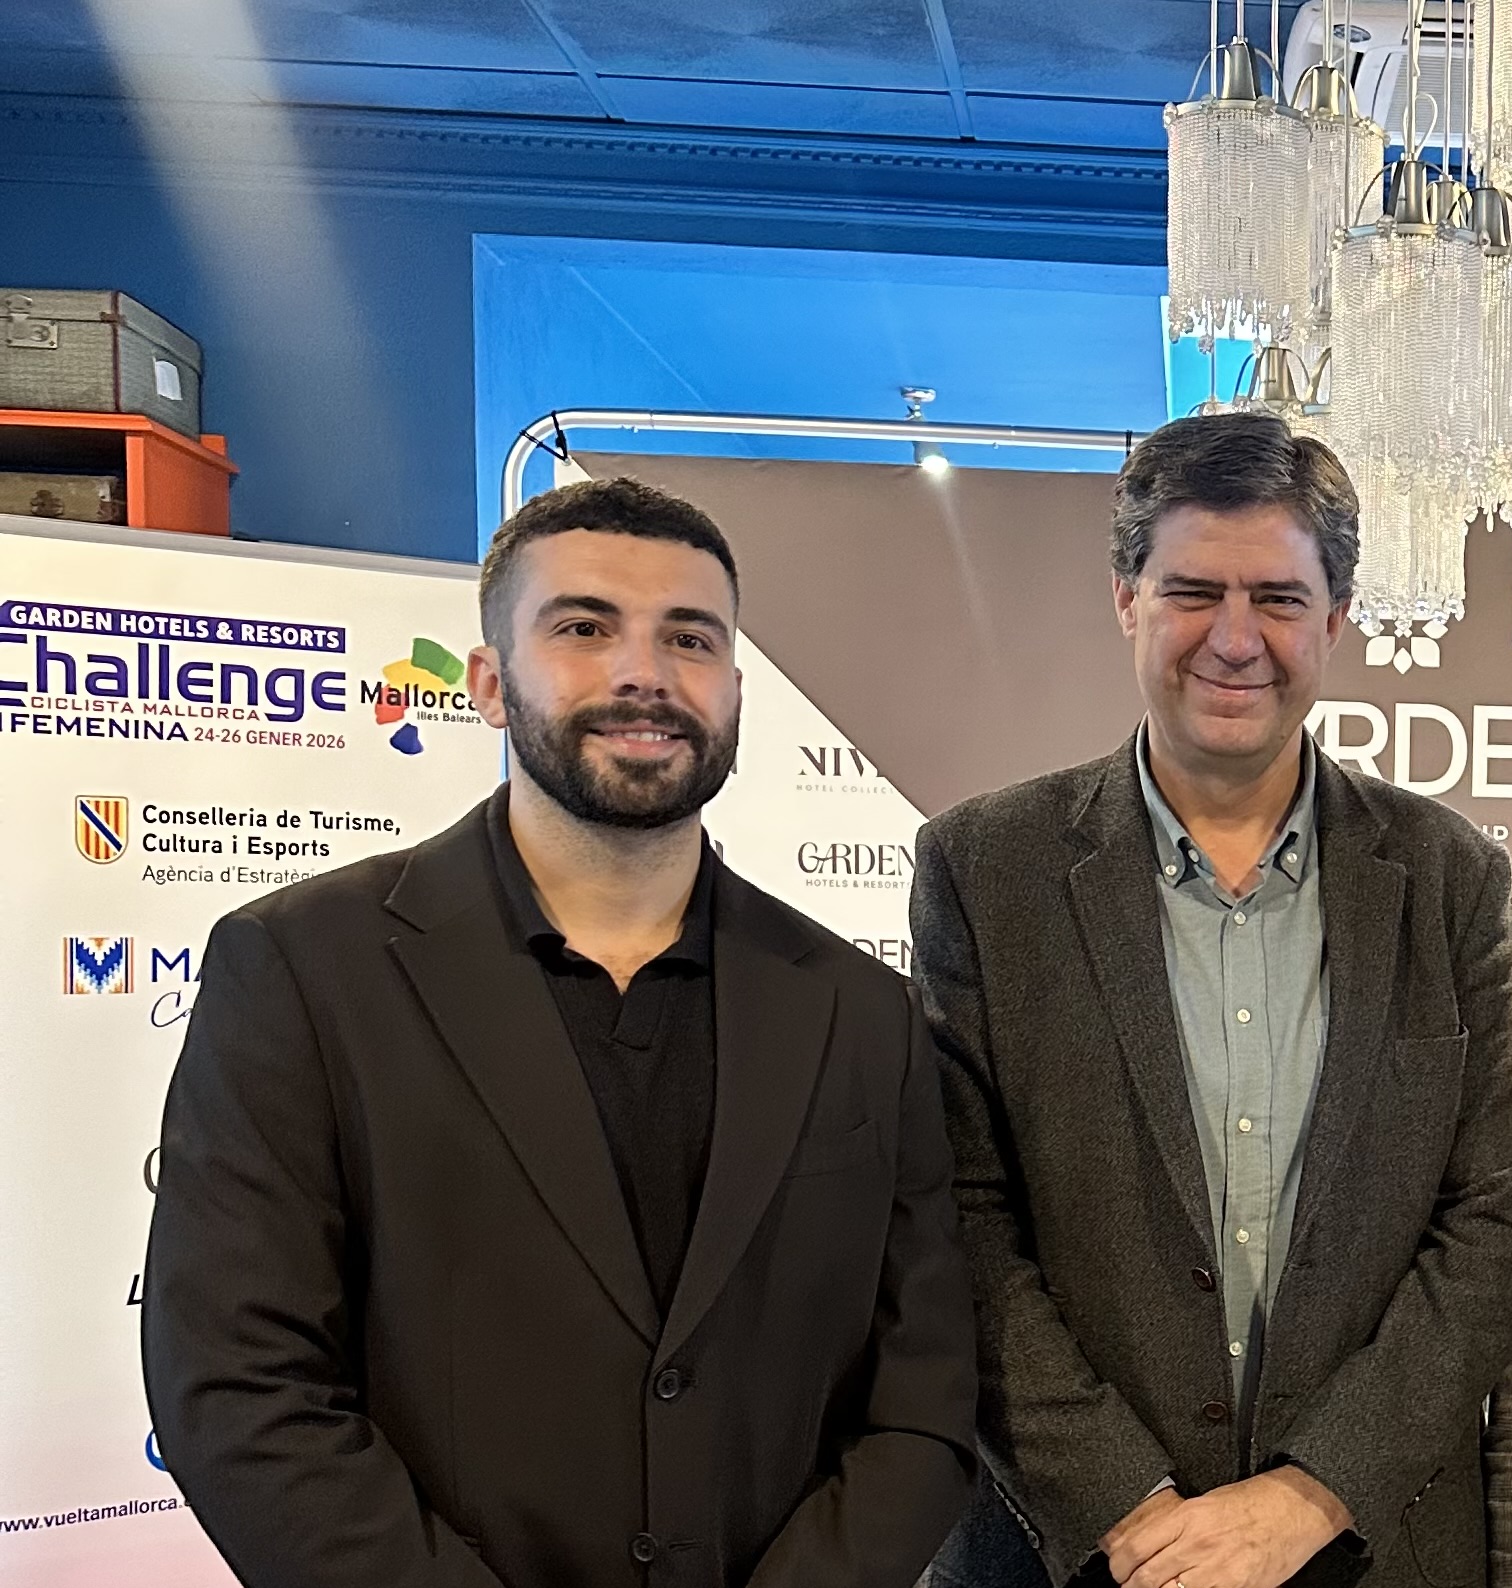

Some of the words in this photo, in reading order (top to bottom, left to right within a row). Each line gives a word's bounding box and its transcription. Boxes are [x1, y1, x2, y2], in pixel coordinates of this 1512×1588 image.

[10, 605, 113, 631] GARDEN
[120, 614, 209, 639] HOTELS
[216, 621, 234, 641] &
[241, 623, 340, 649] RESORTS
[31, 696, 134, 714] CICLISTA
[143, 703, 260, 721] MALLORCA
[416, 711, 439, 721] Illes
[442, 713, 481, 724] Balears
[11, 713, 189, 742] FEMENINA
[194, 726, 242, 744] 24-26
[246, 730, 303, 747] GENER
[306, 733, 346, 749] 2026
[797, 745, 878, 777] NIV
[796, 784, 834, 793] HOTEL
[841, 785, 895, 795] COLLEC
[142, 804, 267, 828] Conselleria
[276, 809, 301, 828] de
[309, 811, 401, 836] Turisme,
[142, 833, 223, 855] Cultura
[232, 835, 238, 854] i
[248, 836, 330, 861] Esports
[142, 865, 213, 885] Agència
[806, 879, 848, 888] HOTELS
[853, 880, 859, 888] &
[0, 1498, 188, 1532] ww.vueltamallorca.
